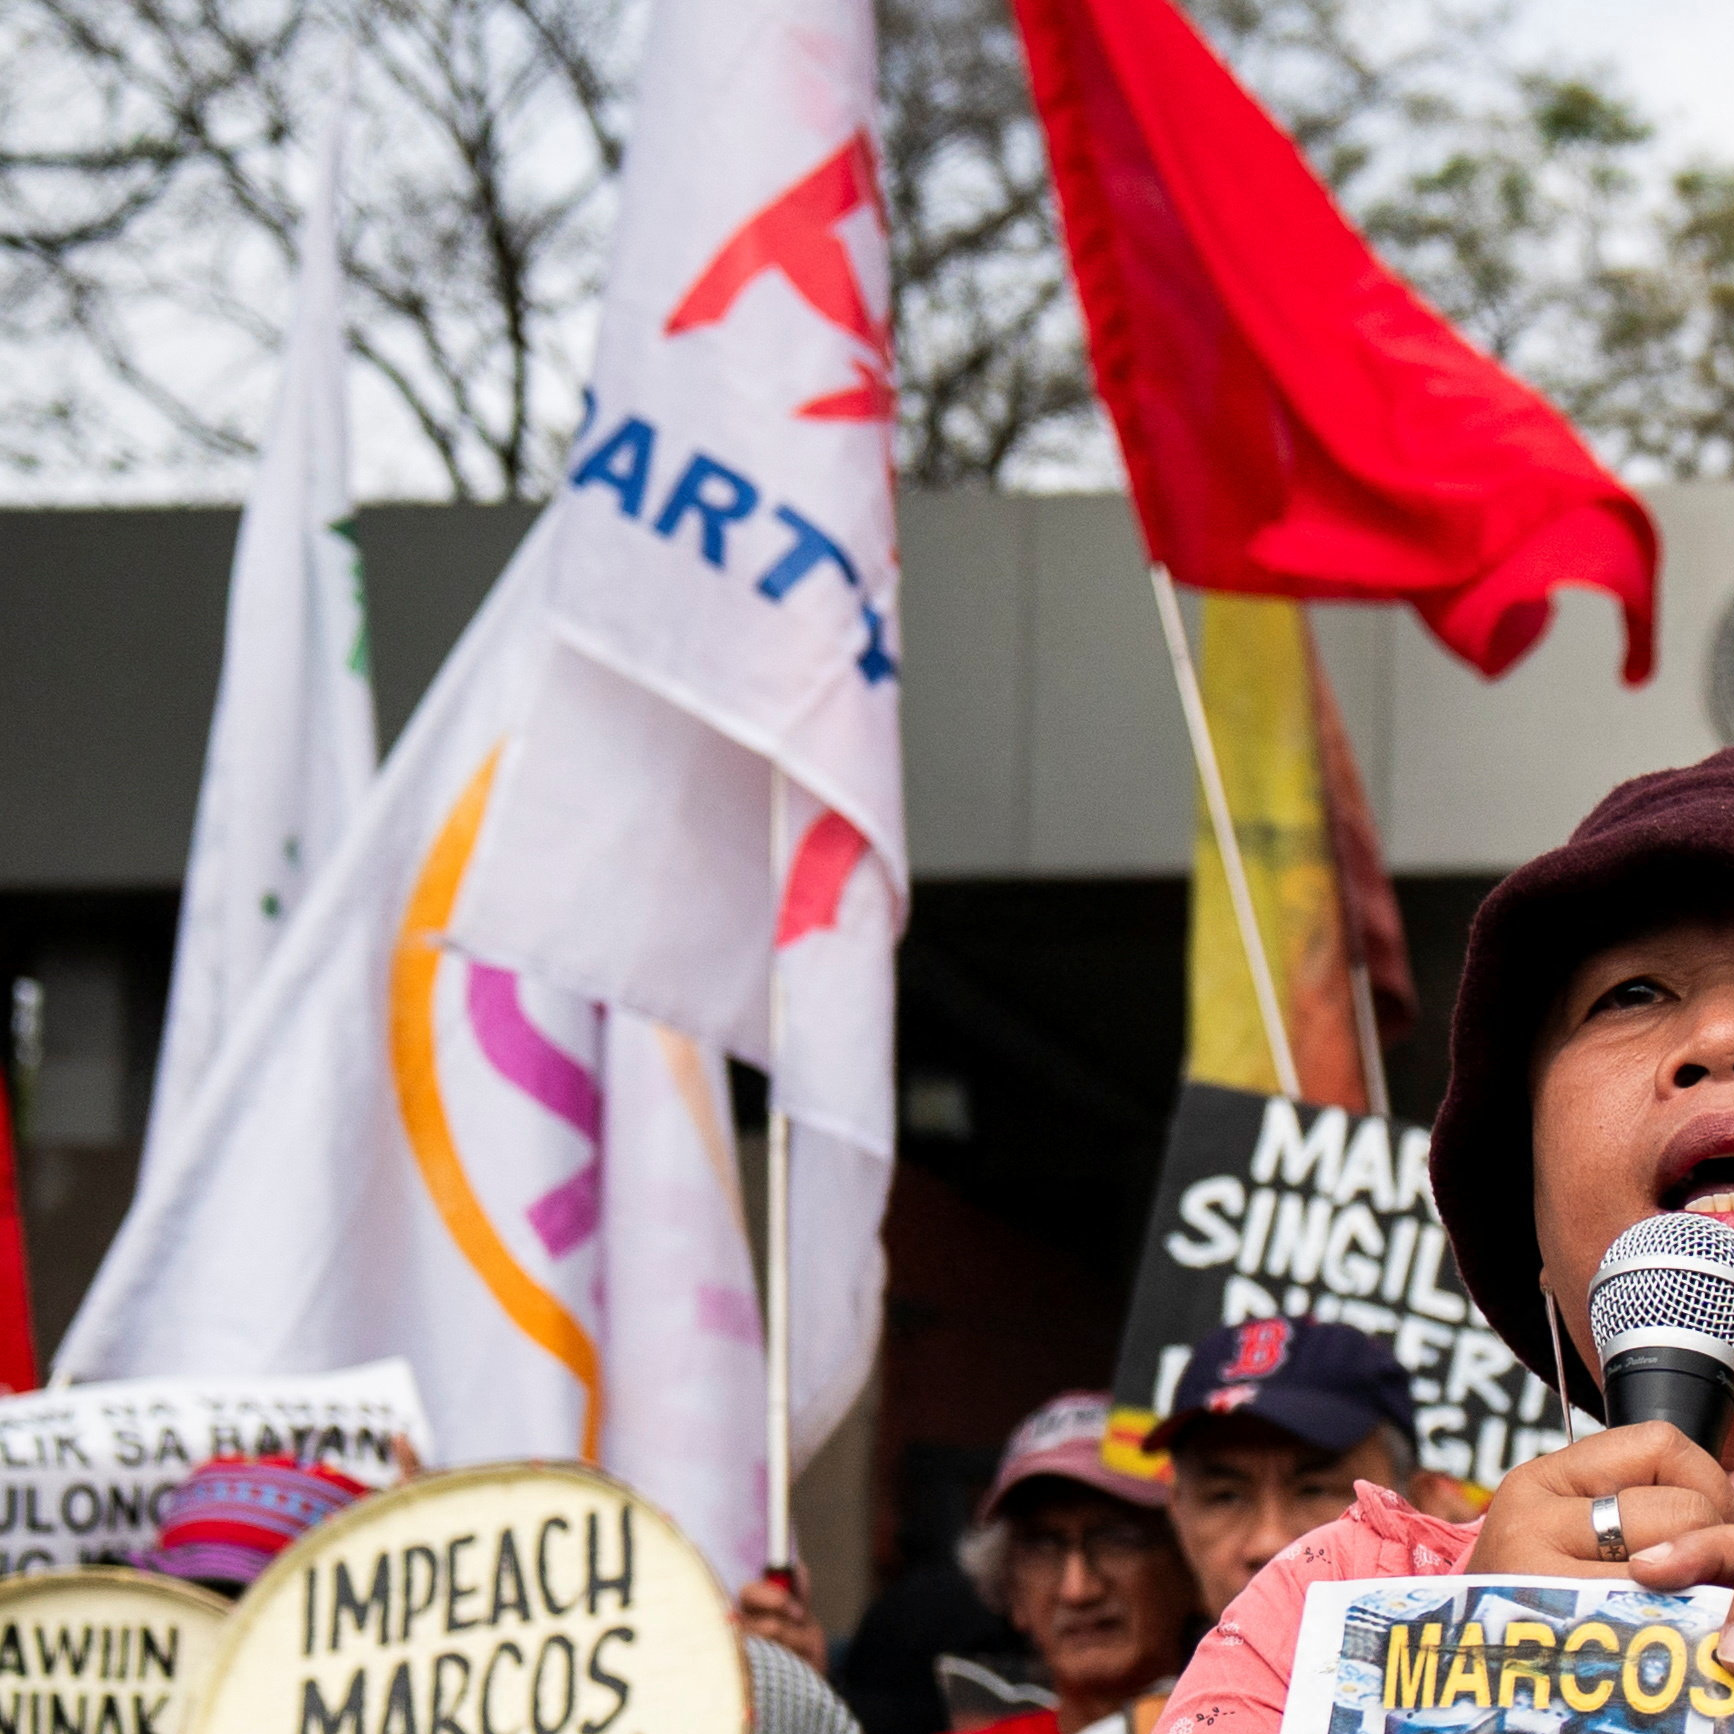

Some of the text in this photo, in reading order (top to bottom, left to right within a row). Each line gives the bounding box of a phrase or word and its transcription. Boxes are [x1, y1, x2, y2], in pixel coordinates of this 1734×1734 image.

[568, 385, 895, 683] ART
[1163, 1176, 1490, 1330] SINGIL
[115, 1427, 190, 1467] SA
[303, 1505, 634, 1657] IMPEACH
